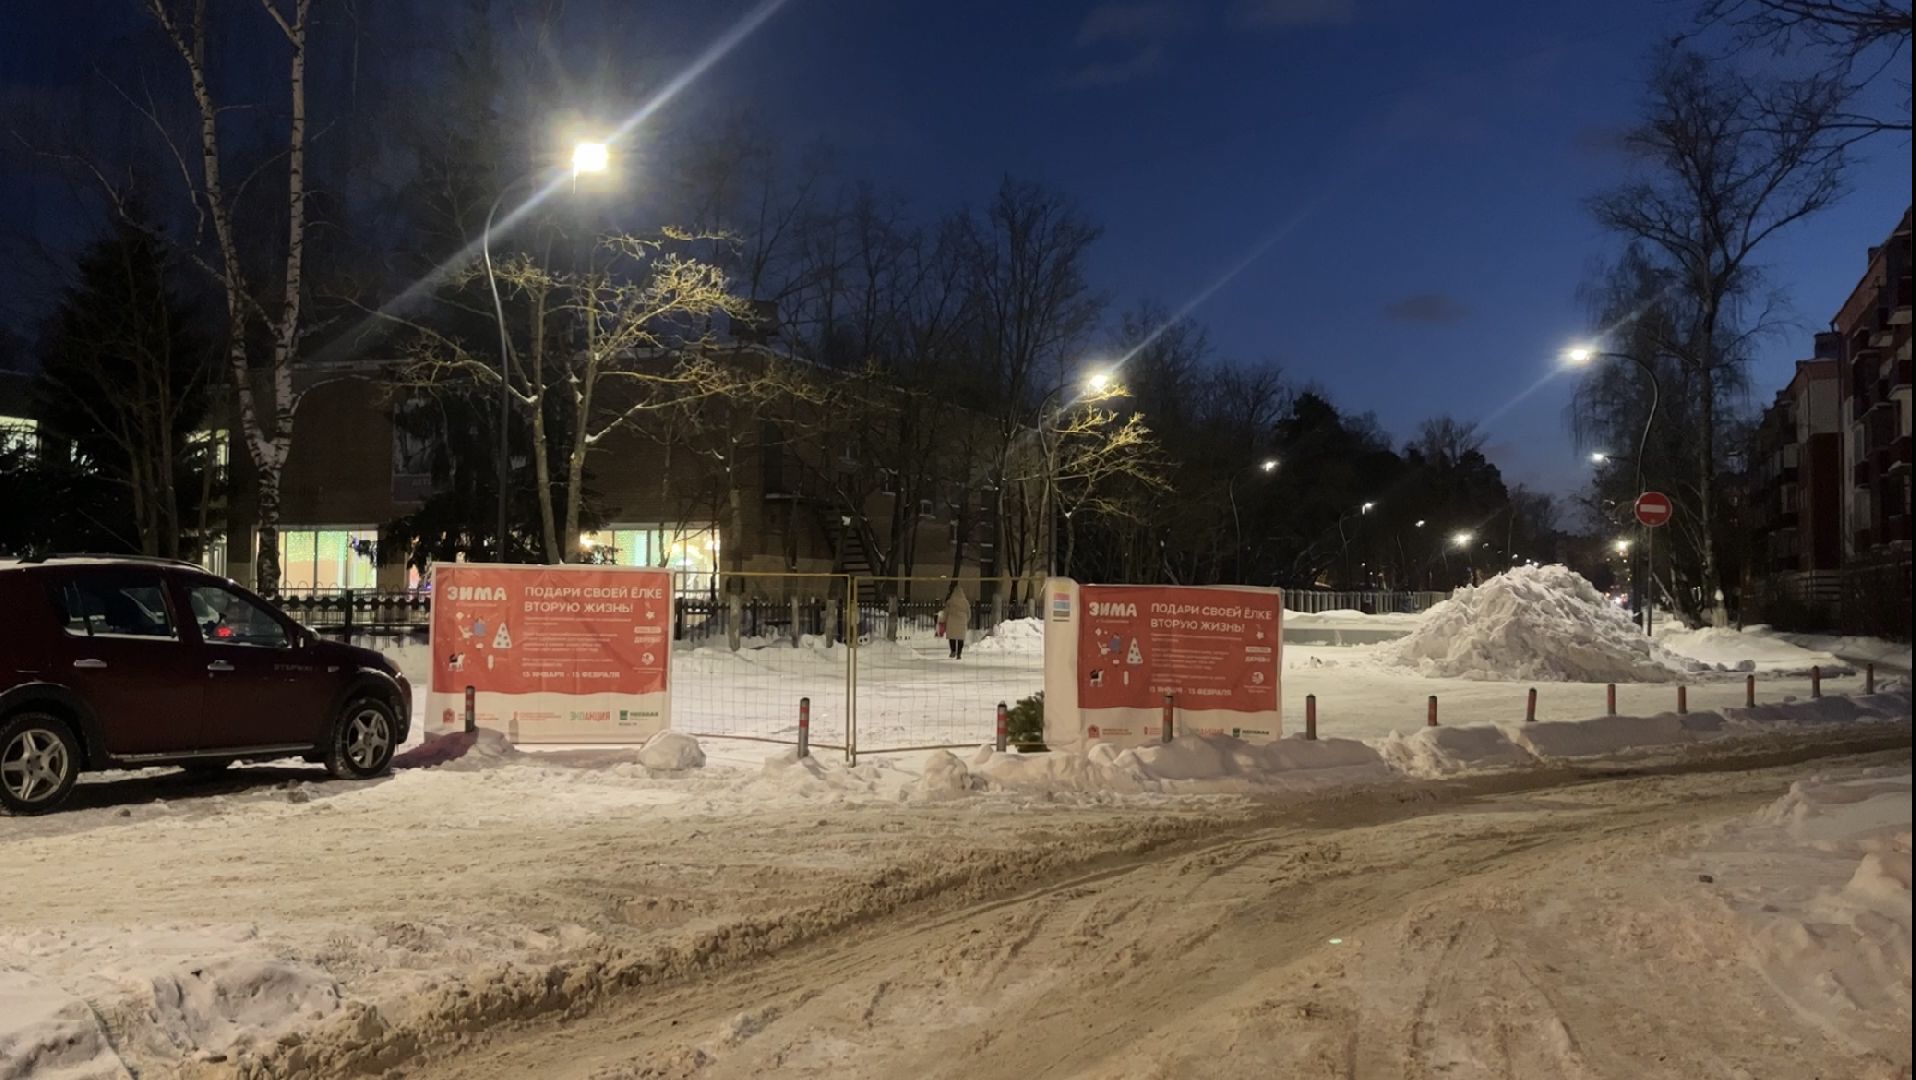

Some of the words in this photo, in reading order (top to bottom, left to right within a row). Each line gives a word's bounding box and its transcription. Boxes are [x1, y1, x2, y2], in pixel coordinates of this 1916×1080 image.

[447, 586, 508, 601] ЗИМА
[524, 586, 581, 599] ПОДАРИ
[583, 586, 628, 600] СВОЕЙ
[631, 585, 663, 600] ЁЛКЕ
[524, 602, 580, 613] ВТОРУЮ
[583, 602, 634, 614] ЖИЗНЬ!
[1088, 602, 1138, 617] ЗИМА
[1151, 603, 1199, 616] ПОДАРИ
[1202, 605, 1242, 619] СВОЕЙ
[1244, 607, 1273, 620] ЁЛКЕ
[1150, 619, 1198, 631] ВТОРУЮ
[1200, 621, 1246, 634] ЖИЗНЬ!
[1197, 687, 1233, 696] ФЕВРАЛЯ
